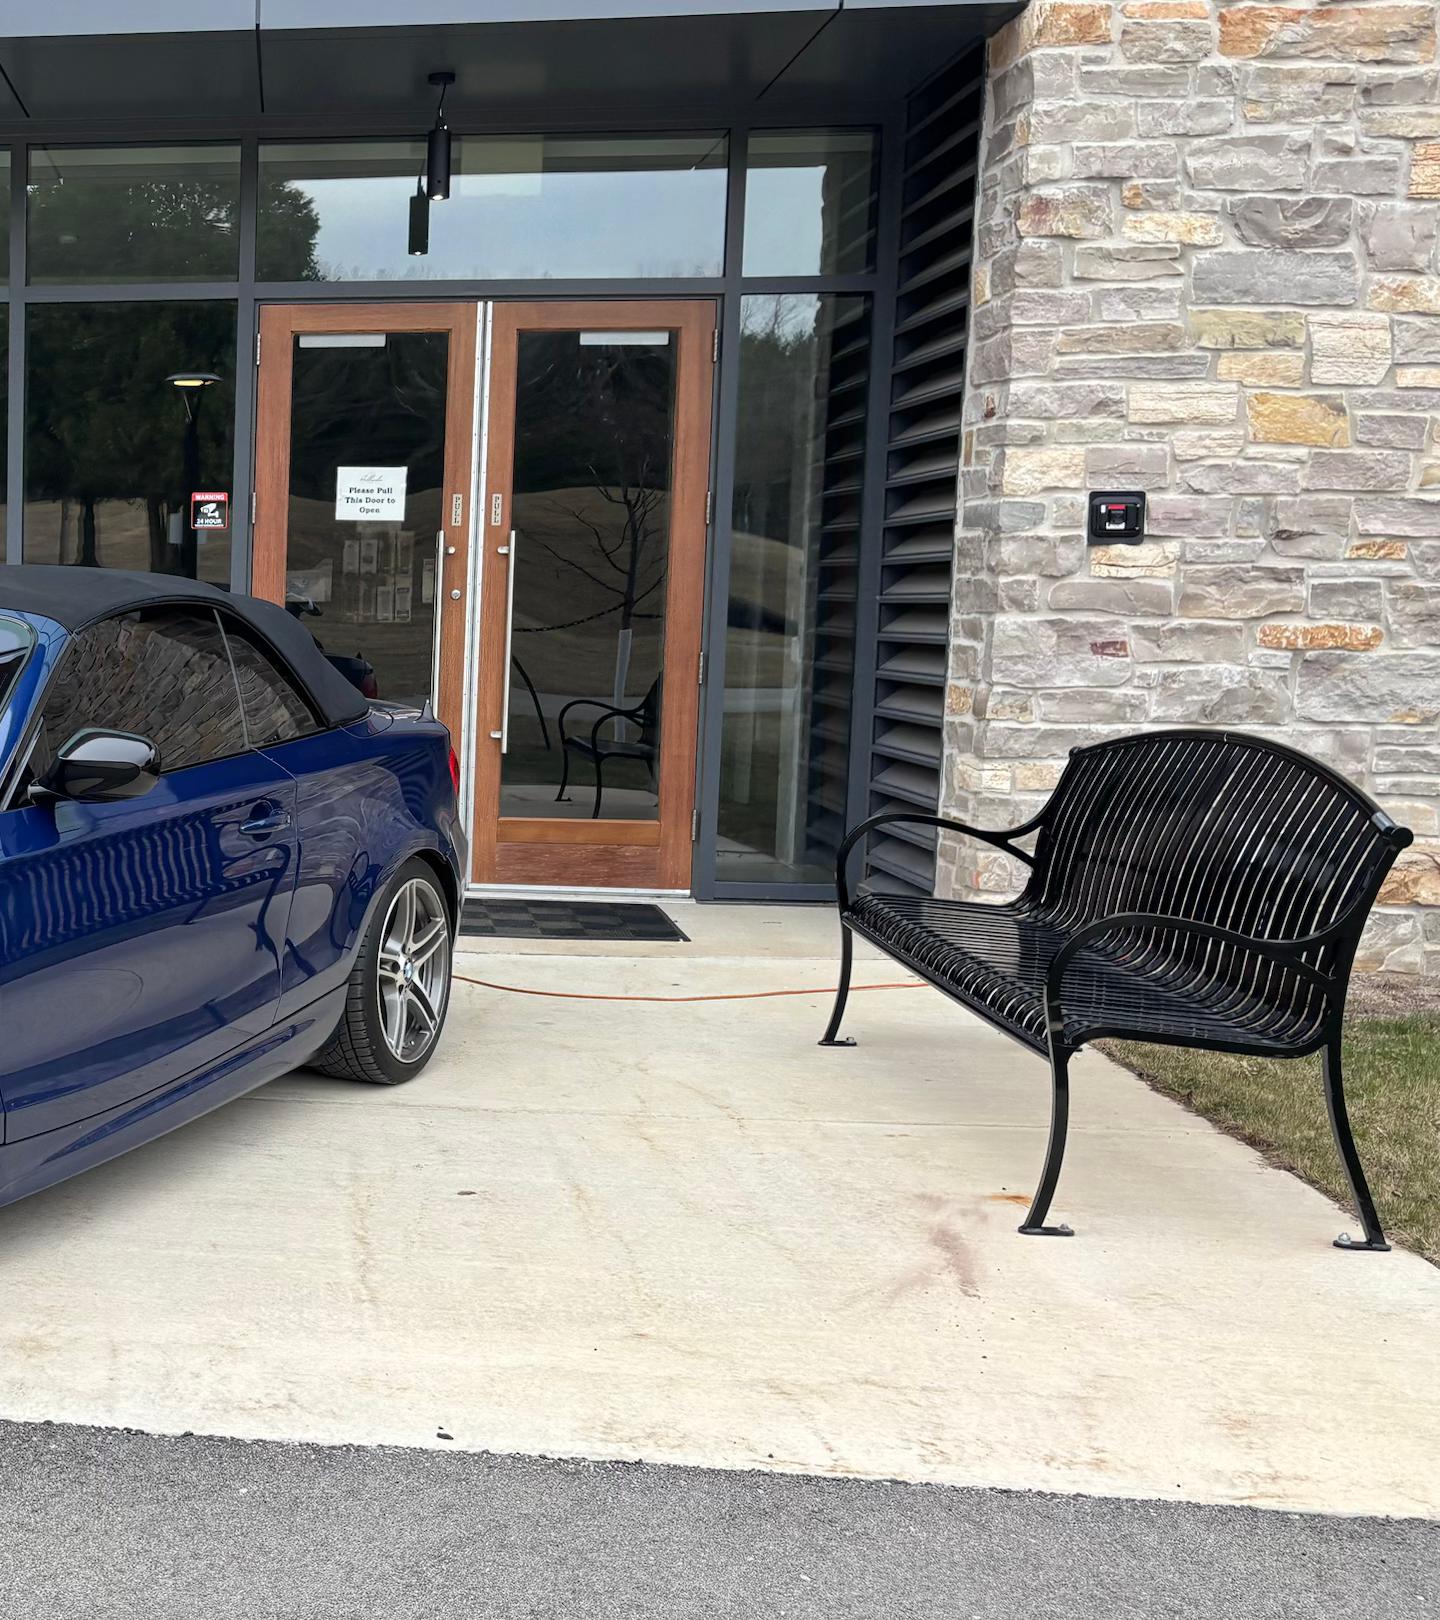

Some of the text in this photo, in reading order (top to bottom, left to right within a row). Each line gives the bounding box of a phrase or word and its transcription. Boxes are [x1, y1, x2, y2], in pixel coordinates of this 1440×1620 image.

[345, 496, 363, 504] This
[365, 496, 384, 504] Door
[359, 506, 380, 514] Open
